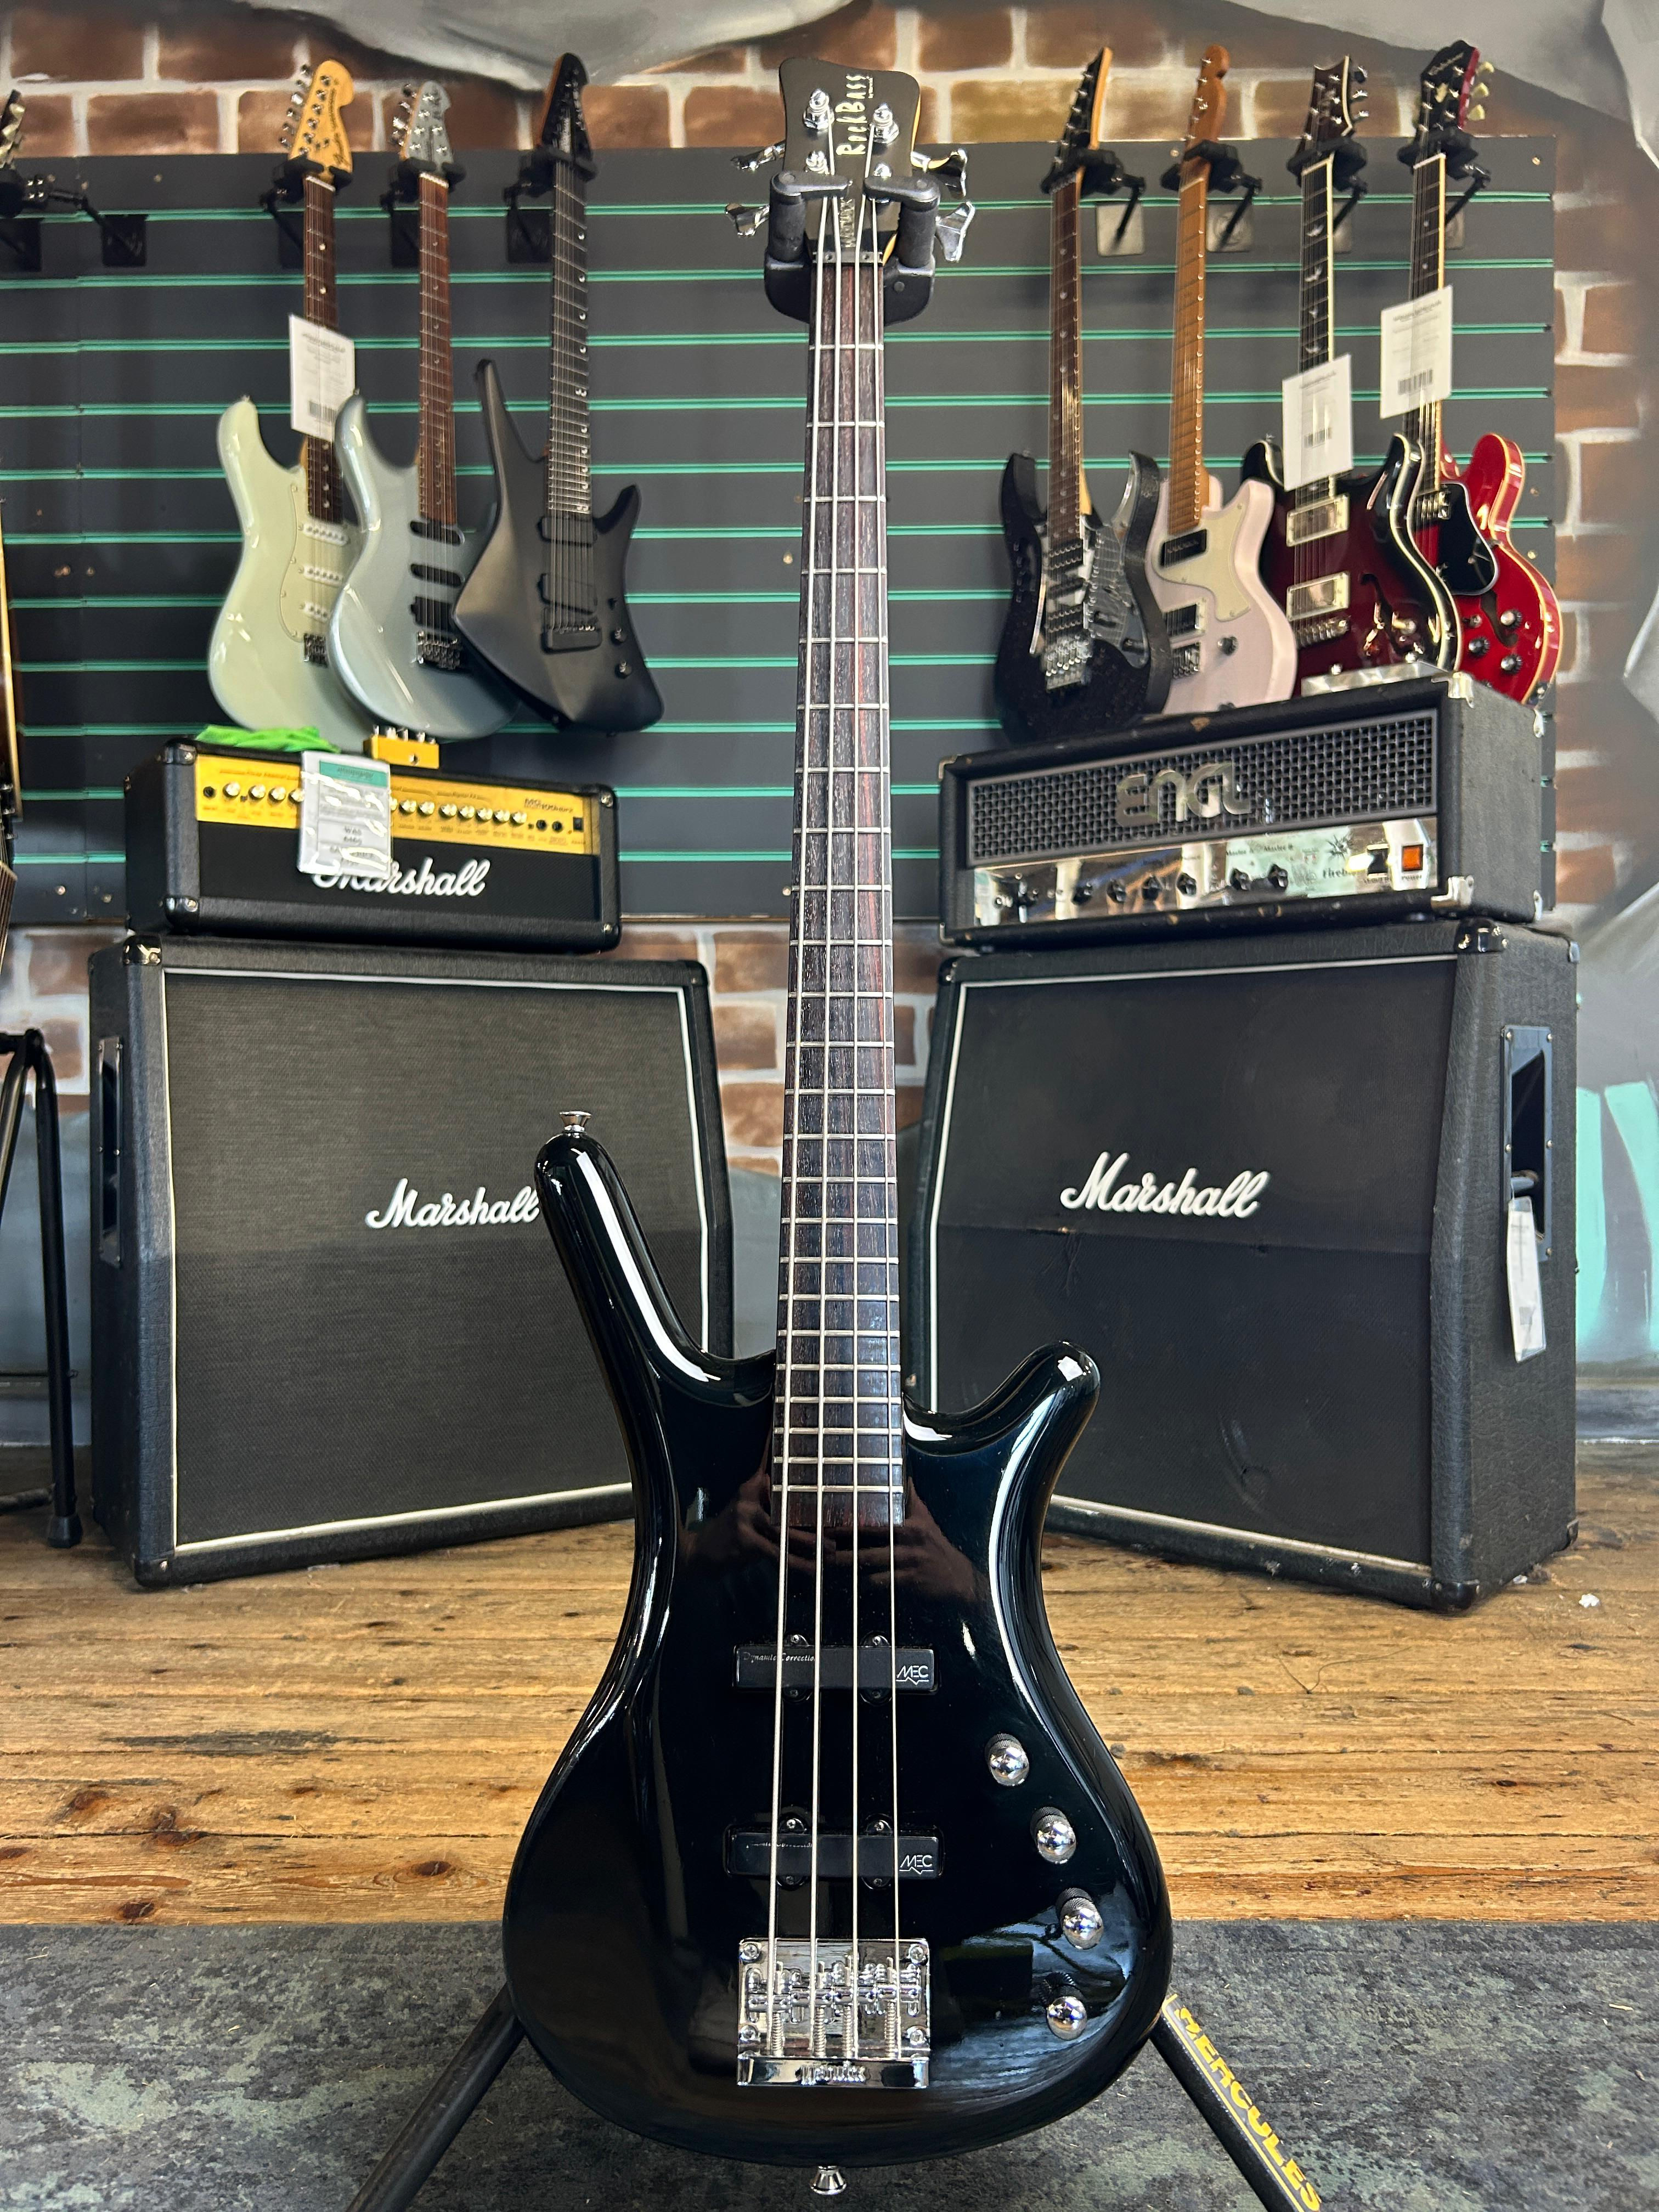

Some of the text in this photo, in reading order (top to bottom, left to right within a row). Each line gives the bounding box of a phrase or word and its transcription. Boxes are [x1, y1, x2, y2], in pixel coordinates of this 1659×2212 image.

[1116, 761, 1252, 827] ENGL
[365, 1177, 540, 1229] Marshall
[1060, 1151, 1271, 1218] Marshall
[781, 1652, 816, 1662] Correctio
[896, 1665, 929, 1678] MEC
[900, 1854, 933, 1868] MEC
[1174, 2006, 1322, 2212] HERCULES
